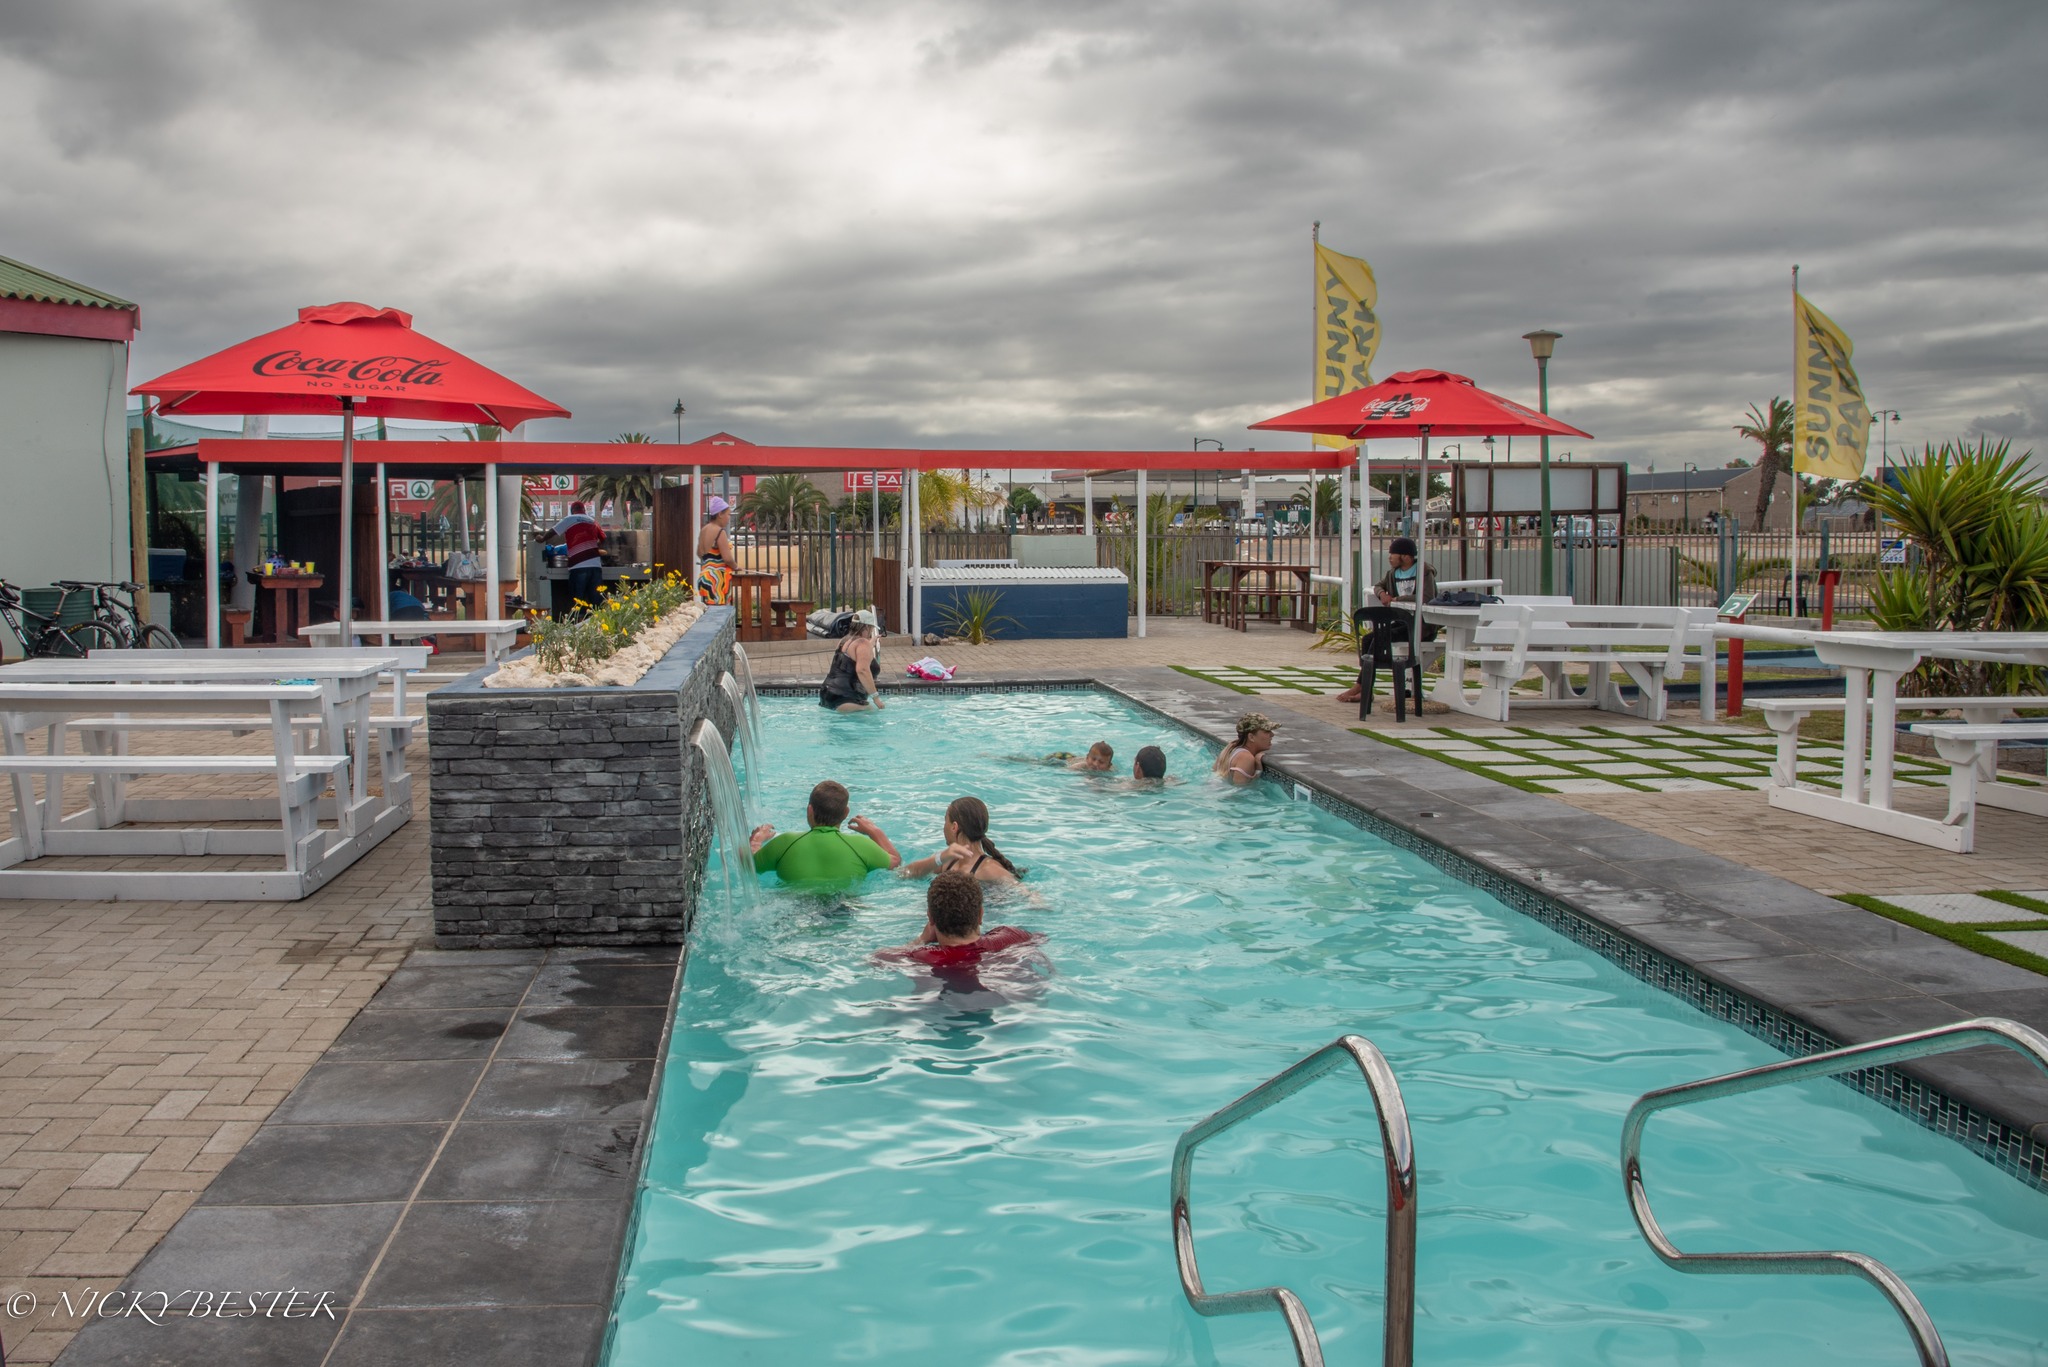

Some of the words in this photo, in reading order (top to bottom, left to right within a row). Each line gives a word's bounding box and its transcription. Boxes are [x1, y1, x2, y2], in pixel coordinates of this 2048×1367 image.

[1325, 263, 1350, 397] UNNY
[252, 350, 450, 386] Coca-Cola
[343, 382, 407, 392] SUGAR
[1361, 397, 1431, 413] Coca-Cola
[862, 475, 905, 485] SPA
[1725, 602, 1741, 614] 2
